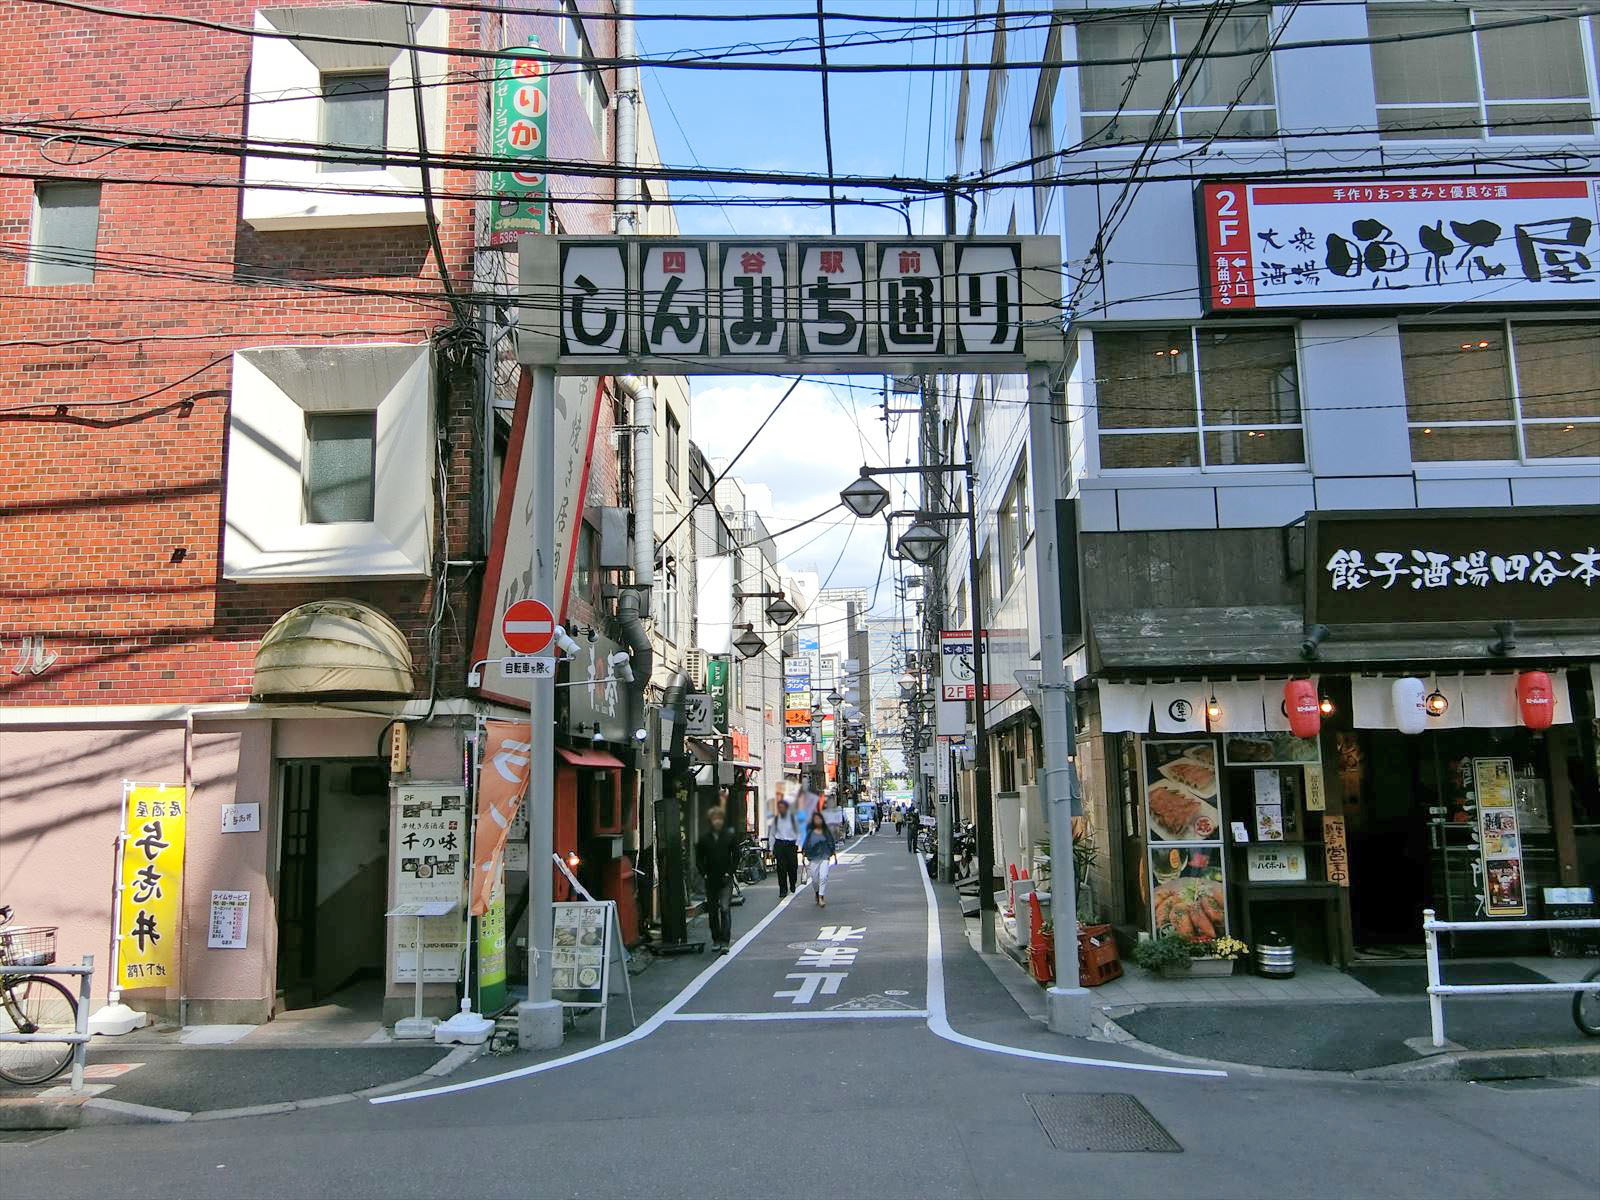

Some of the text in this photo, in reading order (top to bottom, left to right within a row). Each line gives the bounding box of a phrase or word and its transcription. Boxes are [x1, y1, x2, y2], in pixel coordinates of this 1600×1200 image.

[1332, 185, 1508, 201] 手作りおつまみと優良な酒
[1216, 191, 1239, 246] 2F
[662, 250, 921, 273] 四谷駅前
[1326, 217, 1595, 289] 晩杯屋
[1216, 257, 1232, 305] 角曲がる
[1235, 271, 1248, 295] 入口
[571, 273, 1008, 346] しんみち通り
[1326, 547, 1600, 590] 餃子酒場四谷本
[505, 662, 550, 674] 自転車を除く
[948, 686, 964, 698] 2F
[401, 831, 458, 851] 千の味
[213, 893, 248, 901] タイムサービス
